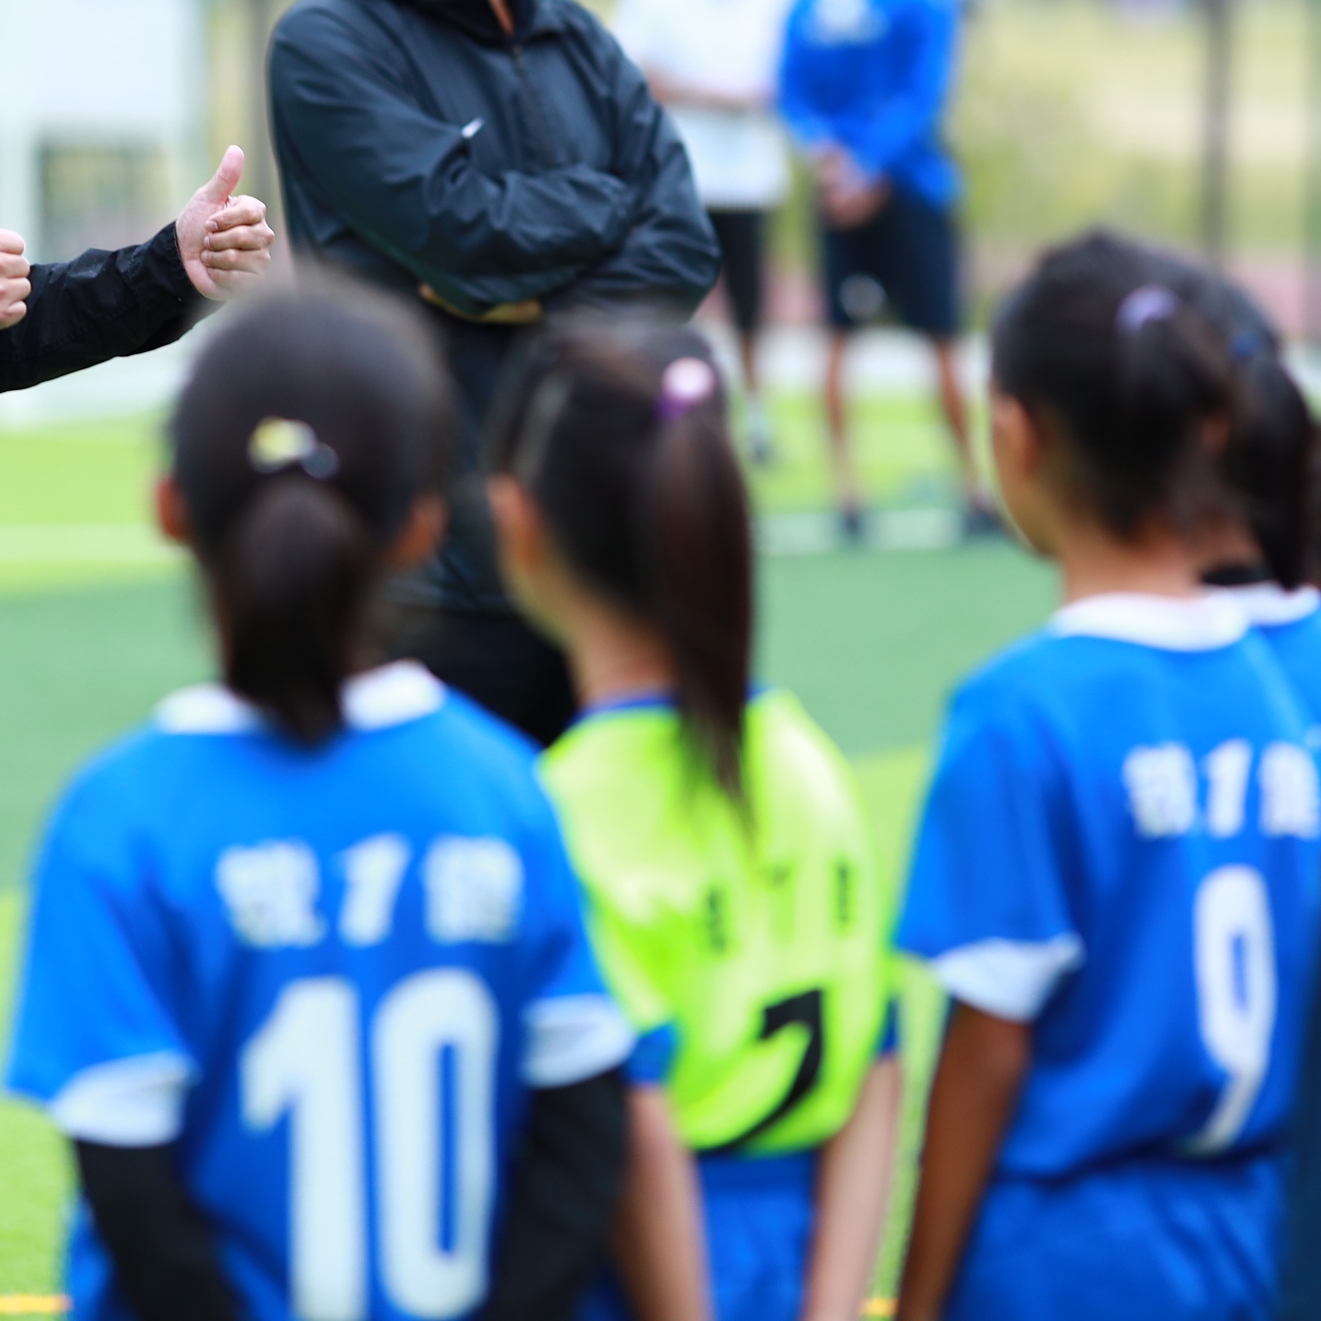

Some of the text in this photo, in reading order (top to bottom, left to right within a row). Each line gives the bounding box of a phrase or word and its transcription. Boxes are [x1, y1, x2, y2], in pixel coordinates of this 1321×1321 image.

[241, 967, 498, 1321] 10
[698, 988, 822, 1152] 7
[1190, 864, 1274, 1152] 9
